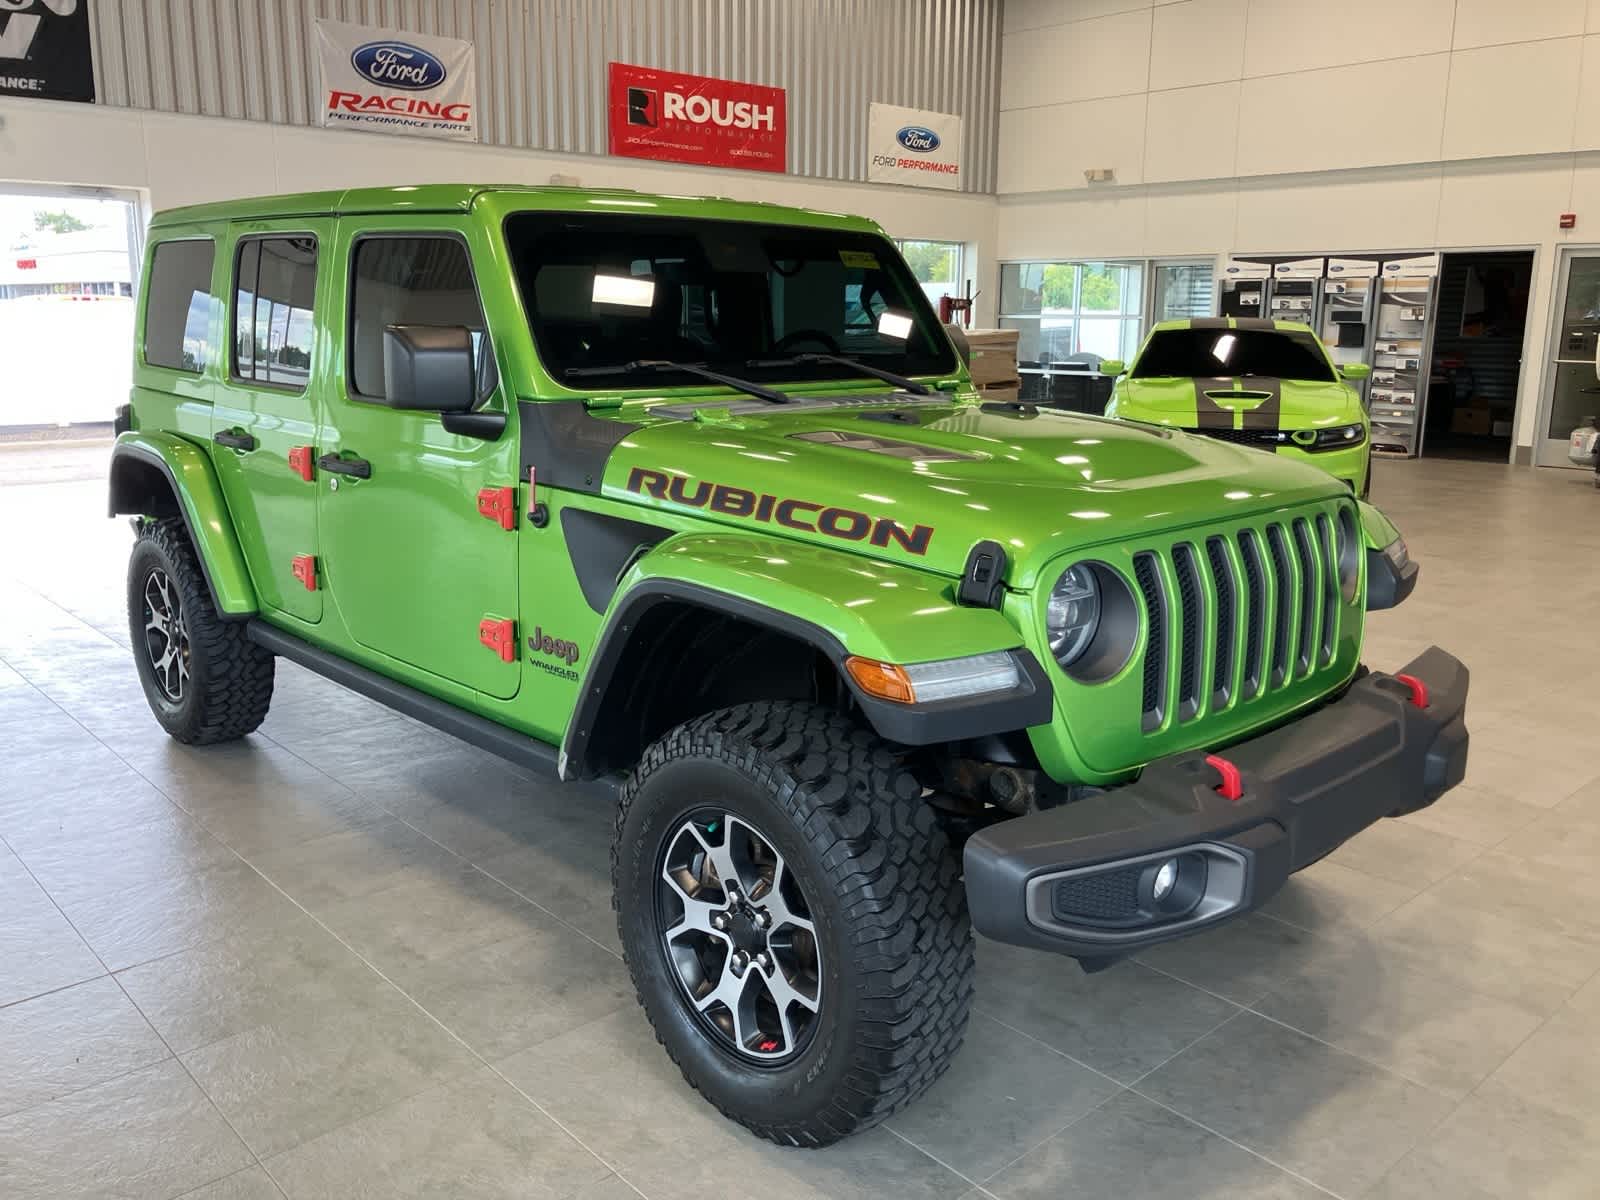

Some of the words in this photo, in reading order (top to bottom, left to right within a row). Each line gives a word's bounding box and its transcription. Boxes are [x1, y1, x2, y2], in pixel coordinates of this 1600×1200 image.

[369, 47, 429, 84] Ford
[328, 90, 471, 122] RACING
[328, 111, 430, 129] PERFORMANCE
[433, 122, 472, 132] PARTS
[663, 92, 776, 132] ROUSH
[904, 129, 933, 149] Ford
[872, 155, 896, 168] FORD
[897, 158, 960, 175] PERFORMANCE
[626, 467, 935, 556] RUBICON
[528, 625, 580, 667] Jeep
[529, 656, 579, 679] WRANGLER
